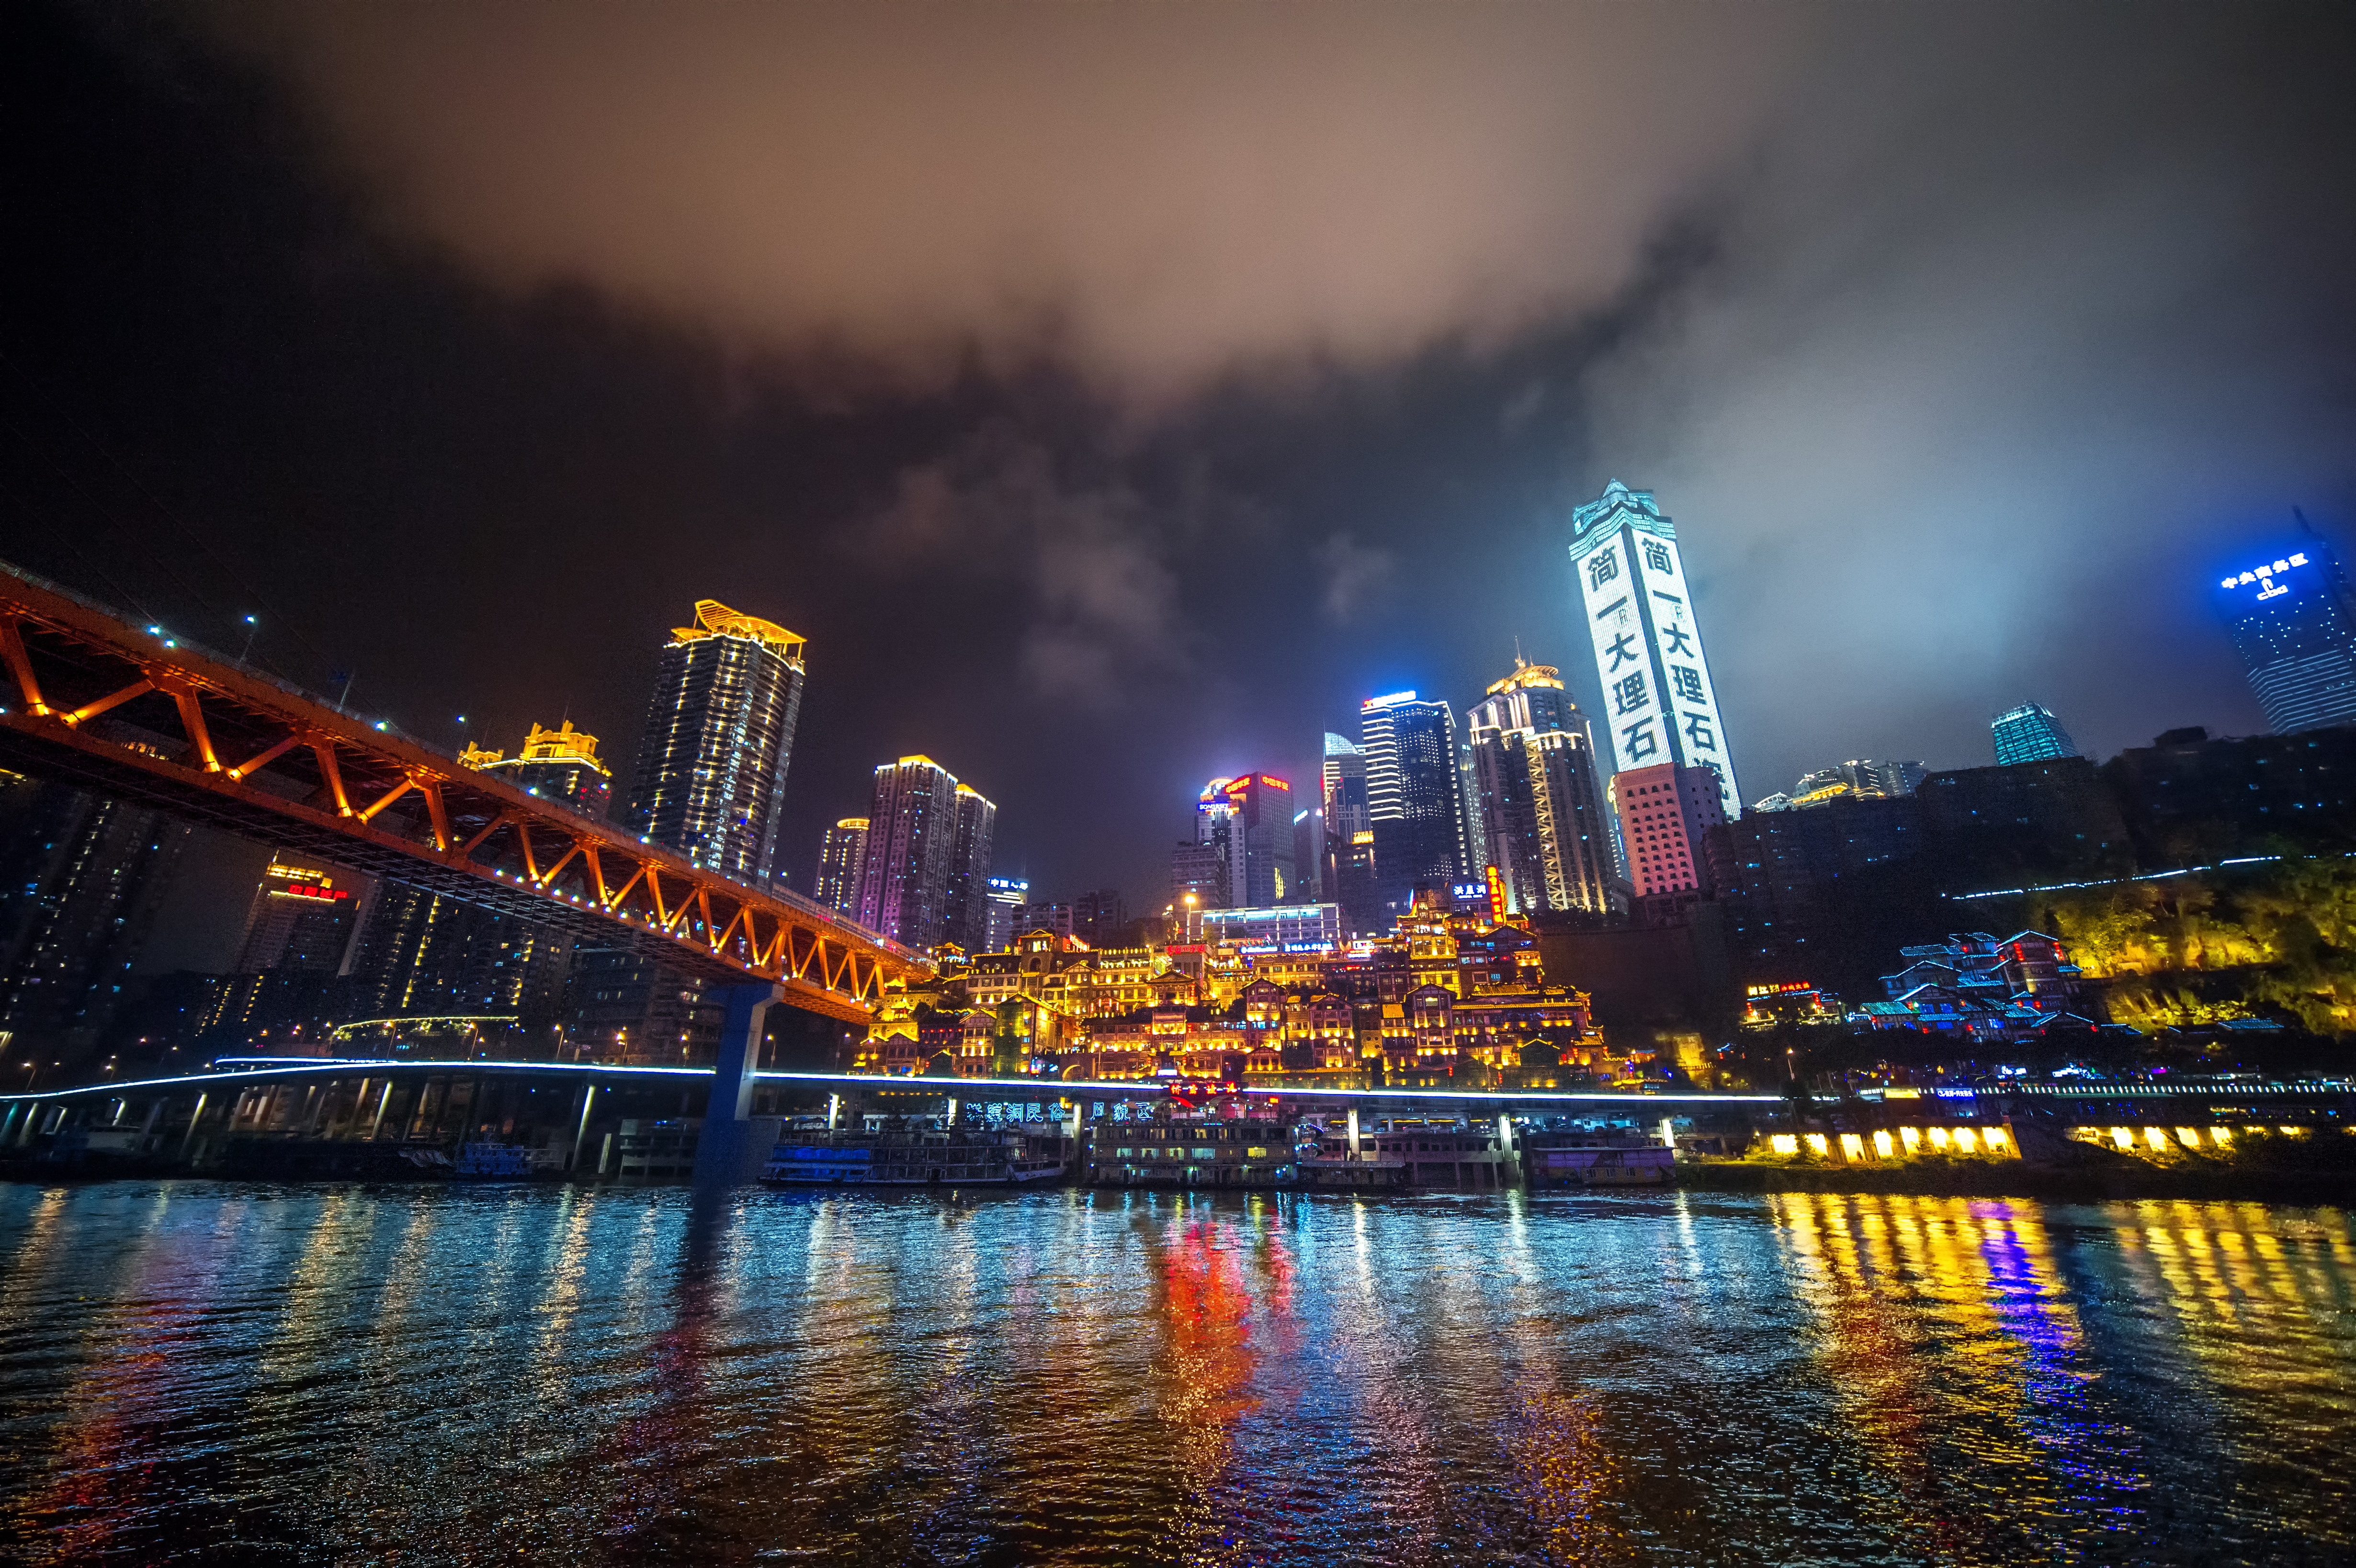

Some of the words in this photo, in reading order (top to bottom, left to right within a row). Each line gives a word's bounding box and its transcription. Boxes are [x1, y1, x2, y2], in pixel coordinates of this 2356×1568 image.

[1587, 545, 1657, 763] 简一大理石
[1642, 537, 1730, 800] 简一大理石
[1225, 777, 1251, 794] 中国平安
[1261, 776, 1289, 791] 中国平安
